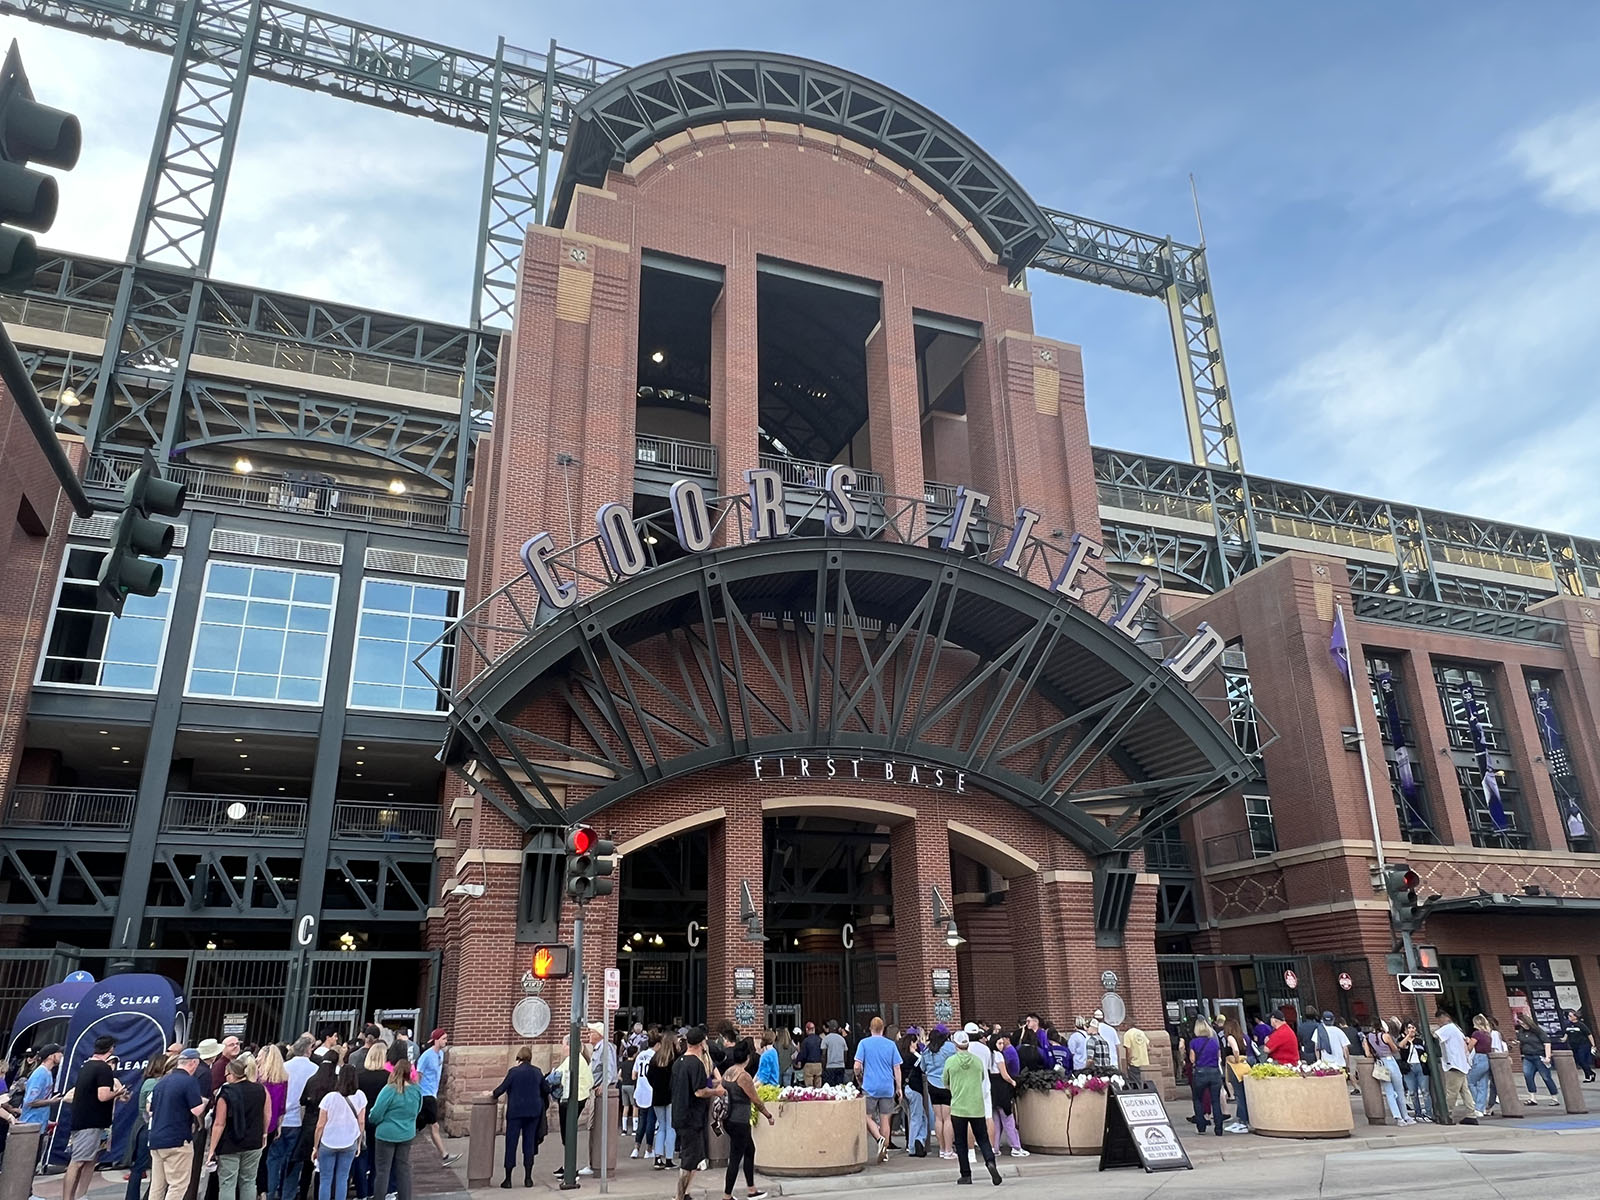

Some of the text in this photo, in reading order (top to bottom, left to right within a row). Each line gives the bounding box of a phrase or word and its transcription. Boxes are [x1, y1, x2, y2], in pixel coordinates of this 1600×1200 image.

[520, 464, 1226, 683] COORS FIELD
[754, 758, 966, 792] FIRST BASE
[297, 914, 315, 945] C
[687, 920, 700, 947] C
[841, 923, 854, 949] C
[120, 996, 160, 1005] CLEAR
[1124, 1099, 1157, 1107] SIDEWALK
[1132, 1109, 1158, 1117] CLOSED
